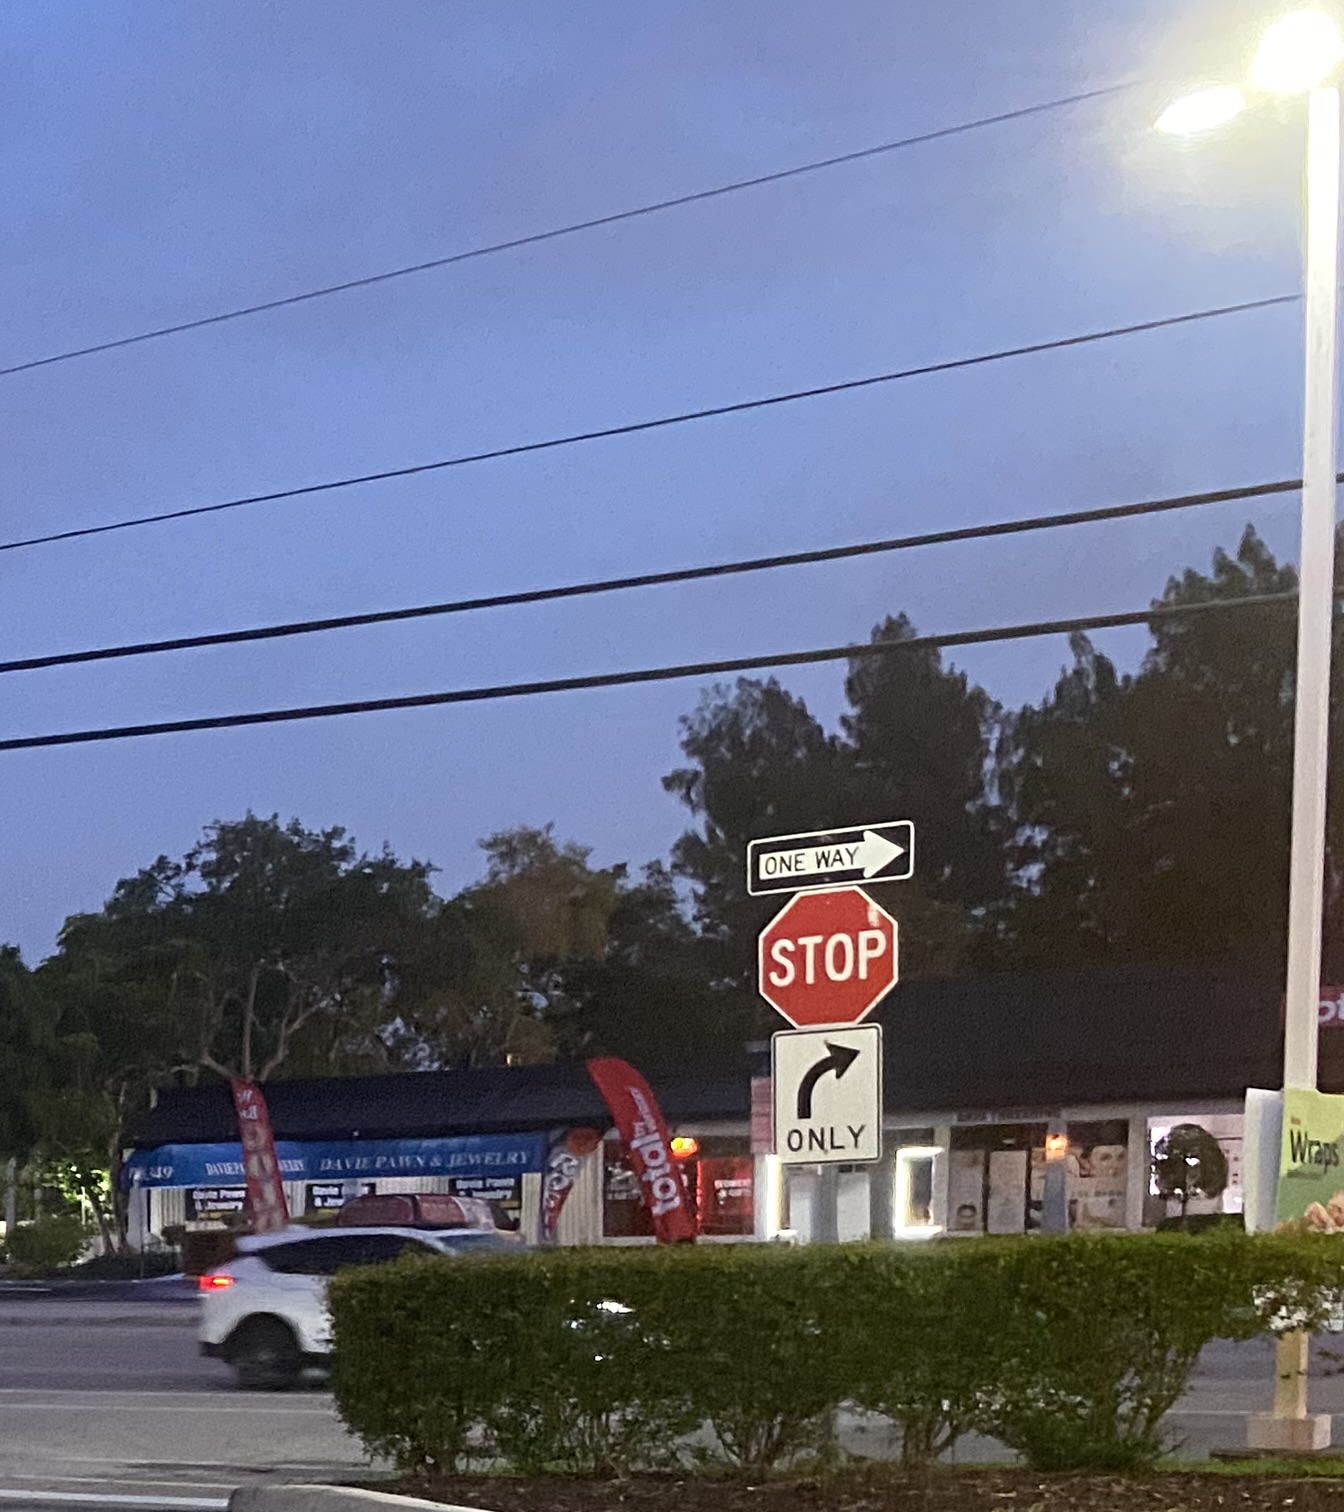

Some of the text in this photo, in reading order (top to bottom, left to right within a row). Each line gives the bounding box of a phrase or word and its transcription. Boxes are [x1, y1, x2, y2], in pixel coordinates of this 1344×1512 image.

[764, 846, 859, 875] ONE WAY
[769, 929, 887, 987] STOP
[787, 1124, 866, 1153] ONLY
[1289, 1128, 1340, 1174] Wraps
[319, 1151, 531, 1171] DAVIE PAWN & JEWELRY
